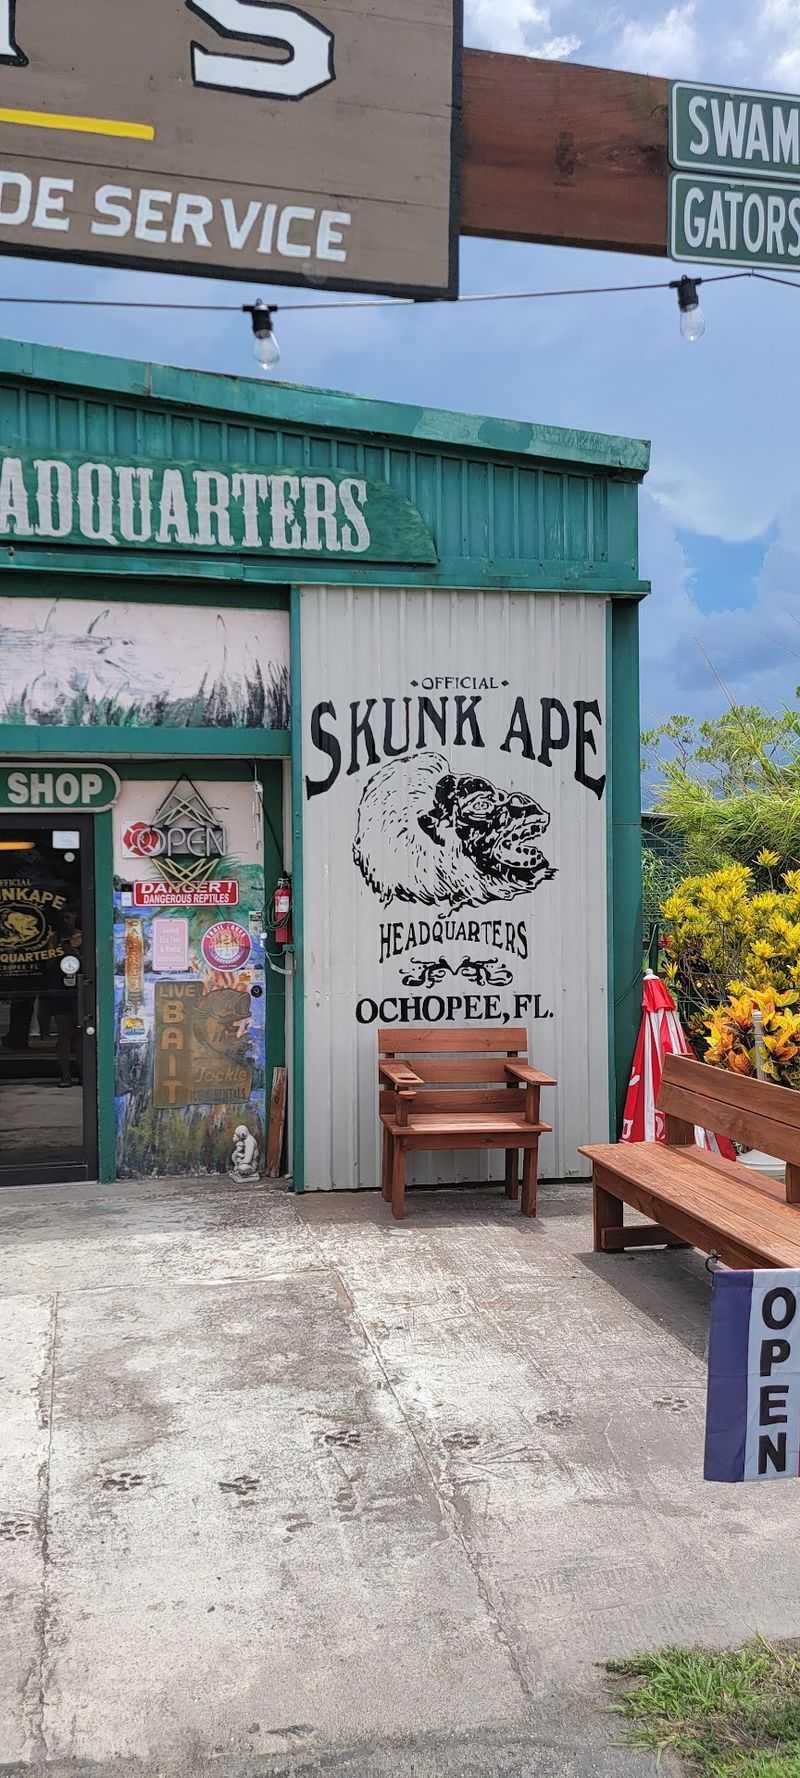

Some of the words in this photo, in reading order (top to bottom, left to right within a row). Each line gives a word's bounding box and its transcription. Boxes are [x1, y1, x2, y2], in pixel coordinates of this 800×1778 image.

[687, 95, 800, 166] SWAM
[90, 184, 352, 262] SERVICE
[683, 187, 800, 257] GATORS
[421, 676, 499, 690] OFFICIAL
[306, 696, 486, 800] SKUNK
[499, 696, 606, 800] APE
[7, 772, 103, 805] SHOP
[137, 827, 225, 857] OPEN
[0, 887, 67, 911] NKAPE
[143, 894, 192, 904] DANGEROUS
[193, 893, 230, 903] REPTILES
[379, 921, 528, 963] HEADQUARTERS
[160, 984, 196, 998] LIVE
[160, 1000, 185, 1104] BAIT
[758, 1286, 797, 1475] OPEN
